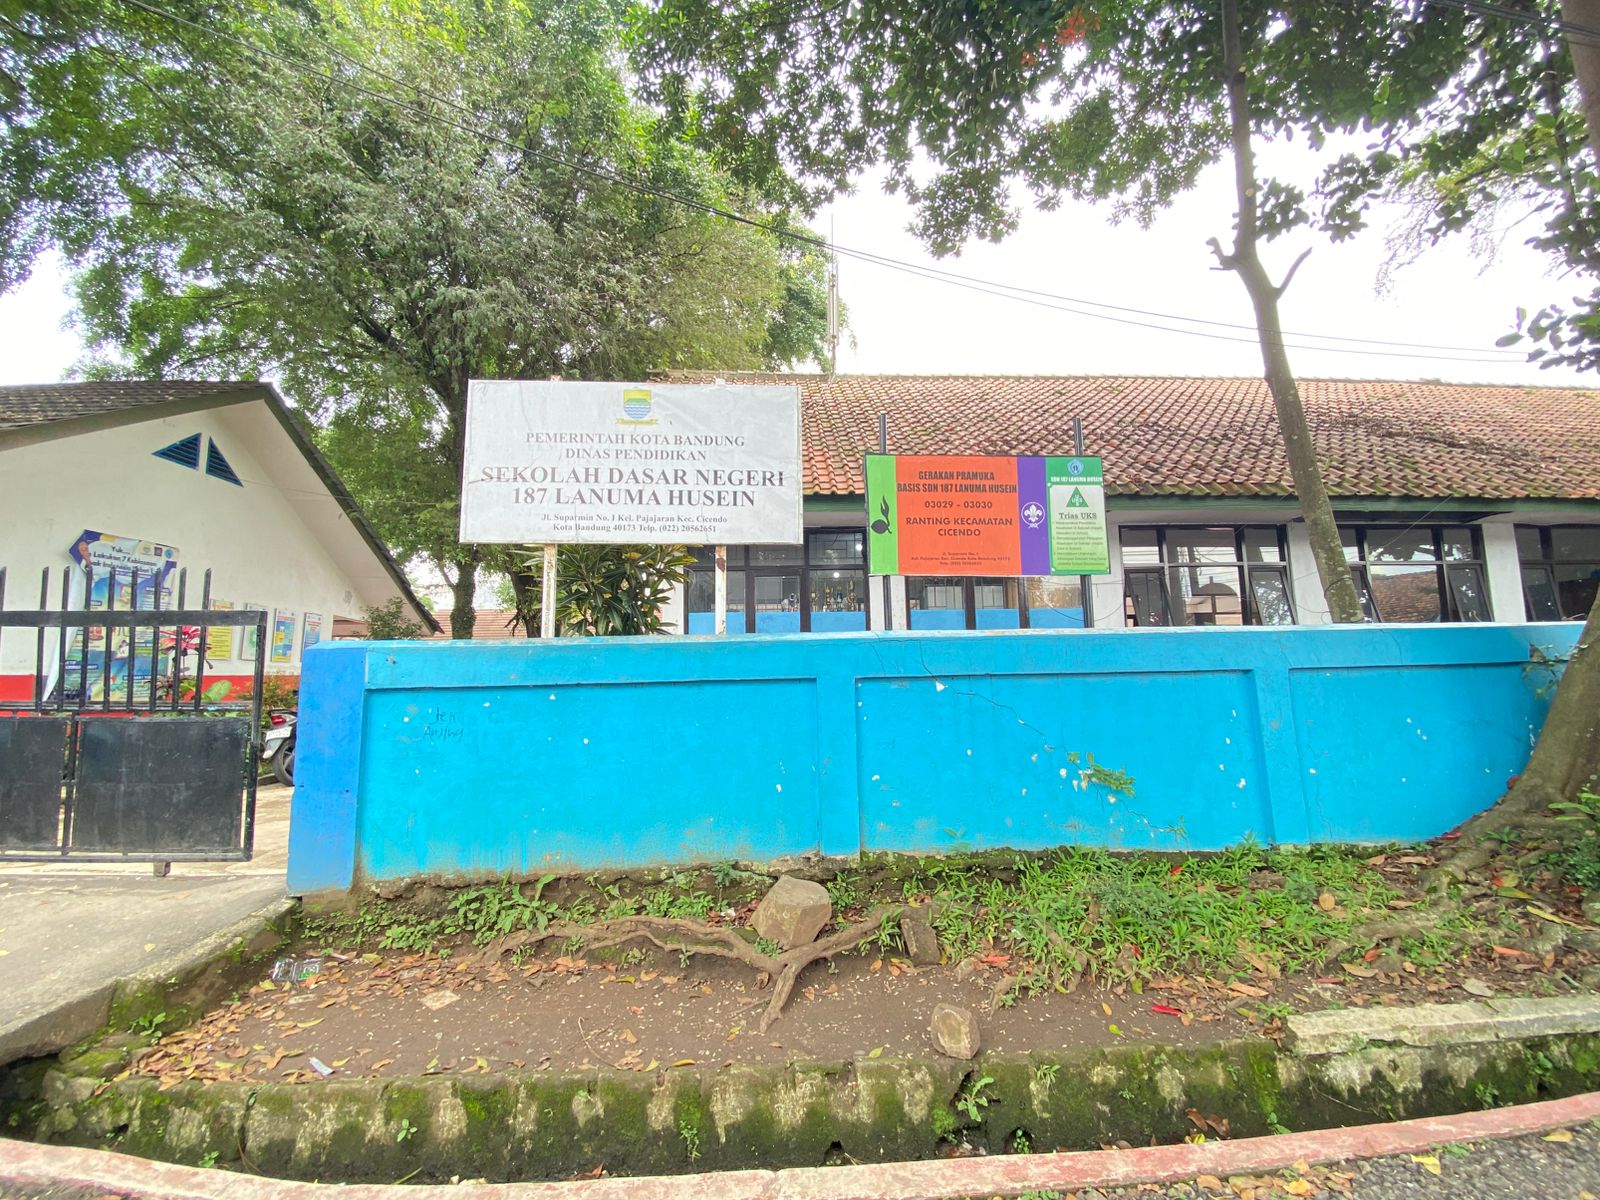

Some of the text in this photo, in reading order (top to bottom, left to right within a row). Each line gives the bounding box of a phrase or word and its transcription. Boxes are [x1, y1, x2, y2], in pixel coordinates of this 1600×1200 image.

[526, 432, 745, 447] PEMERINTAH KOTA BANDUNG
[565, 448, 707, 461] DINAS PENDIDIKAN
[481, 466, 785, 487] SEKOLAH DASAR NEGERI
[918, 470, 995, 481] GERAKAN PRAMUKA
[897, 482, 1017, 494] BASIS SDN 187 LANUMA HUSEIN
[513, 487, 755, 507] 187 LANUMA HUSEIN
[924, 500, 954, 508] 03029
[963, 500, 993, 509] 03030
[553, 514, 594, 524] Suparmin
[618, 514, 632, 522] Kel.
[636, 514, 675, 525] Pajajaran
[677, 515, 695, 523] Kec.
[696, 515, 728, 524] Cicendo
[905, 517, 1013, 526] RANTING KECAMATAN
[553, 523, 573, 532] Kota
[575, 523, 611, 534] Bandung
[612, 524, 636, 532] 40173
[937, 528, 981, 537] CICENDO
